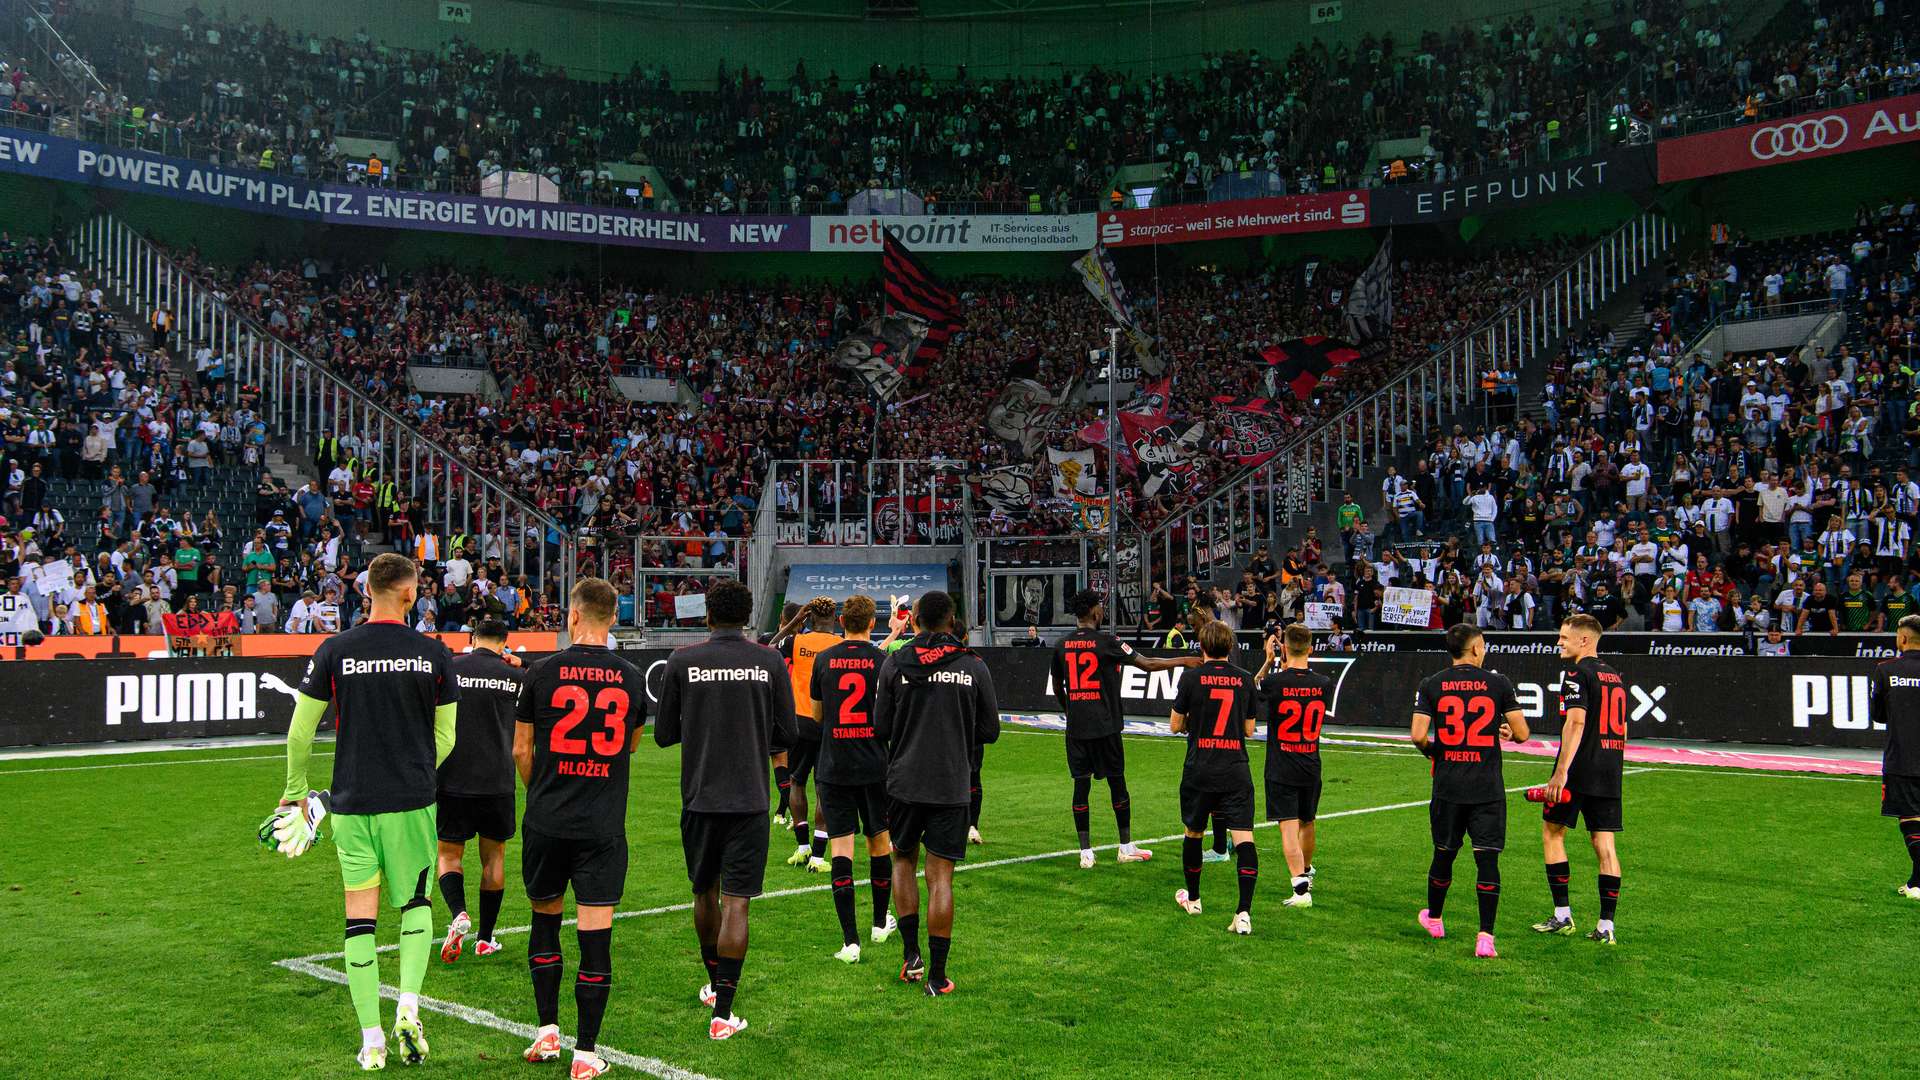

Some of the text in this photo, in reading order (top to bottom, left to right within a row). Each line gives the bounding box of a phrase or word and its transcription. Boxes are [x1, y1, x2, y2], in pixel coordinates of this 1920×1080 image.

[1417, 161, 1608, 214] EFFPUNKT
[78, 150, 706, 243] POWER AUF'M PLATZ. ENERGIE VOM NIEDERRHEIN.
[990, 223, 1070, 233] IT-Services aus
[1130, 222, 1175, 237] starpac
[1186, 217, 1211, 231] weil
[1215, 215, 1234, 229] Sie
[1237, 210, 1300, 227] Mehrwert
[1304, 207, 1335, 222] sind.
[981, 234, 1079, 245] Mönchengladbach
[805, 574, 932, 583] Elektrisiert
[852, 582, 923, 591] Kurve.
[1065, 640, 1087, 649] BAYER
[1648, 640, 1744, 656] interwette
[342, 655, 433, 676] Barmenia
[829, 658, 861, 669] BAYER
[1065, 651, 1100, 690] 12
[560, 667, 604, 681] BAYER
[688, 666, 769, 683] Barmenia
[1201, 676, 1230, 687] BAYER
[1283, 687, 1310, 698] BAYER
[1442, 681, 1472, 691] BAYER
[106, 672, 256, 725] PUMA
[838, 672, 868, 725] 2
[1070, 692, 1100, 701] TAPSOBA
[1792, 674, 1871, 730] PU
[1210, 688, 1235, 737] 7
[1600, 685, 1627, 736] 10
[550, 685, 630, 756] 23
[1277, 700, 1326, 743] 20
[1437, 695, 1496, 747] 32
[1445, 751, 1481, 763] PUERTA
[558, 760, 611, 777] HLOŽEK
